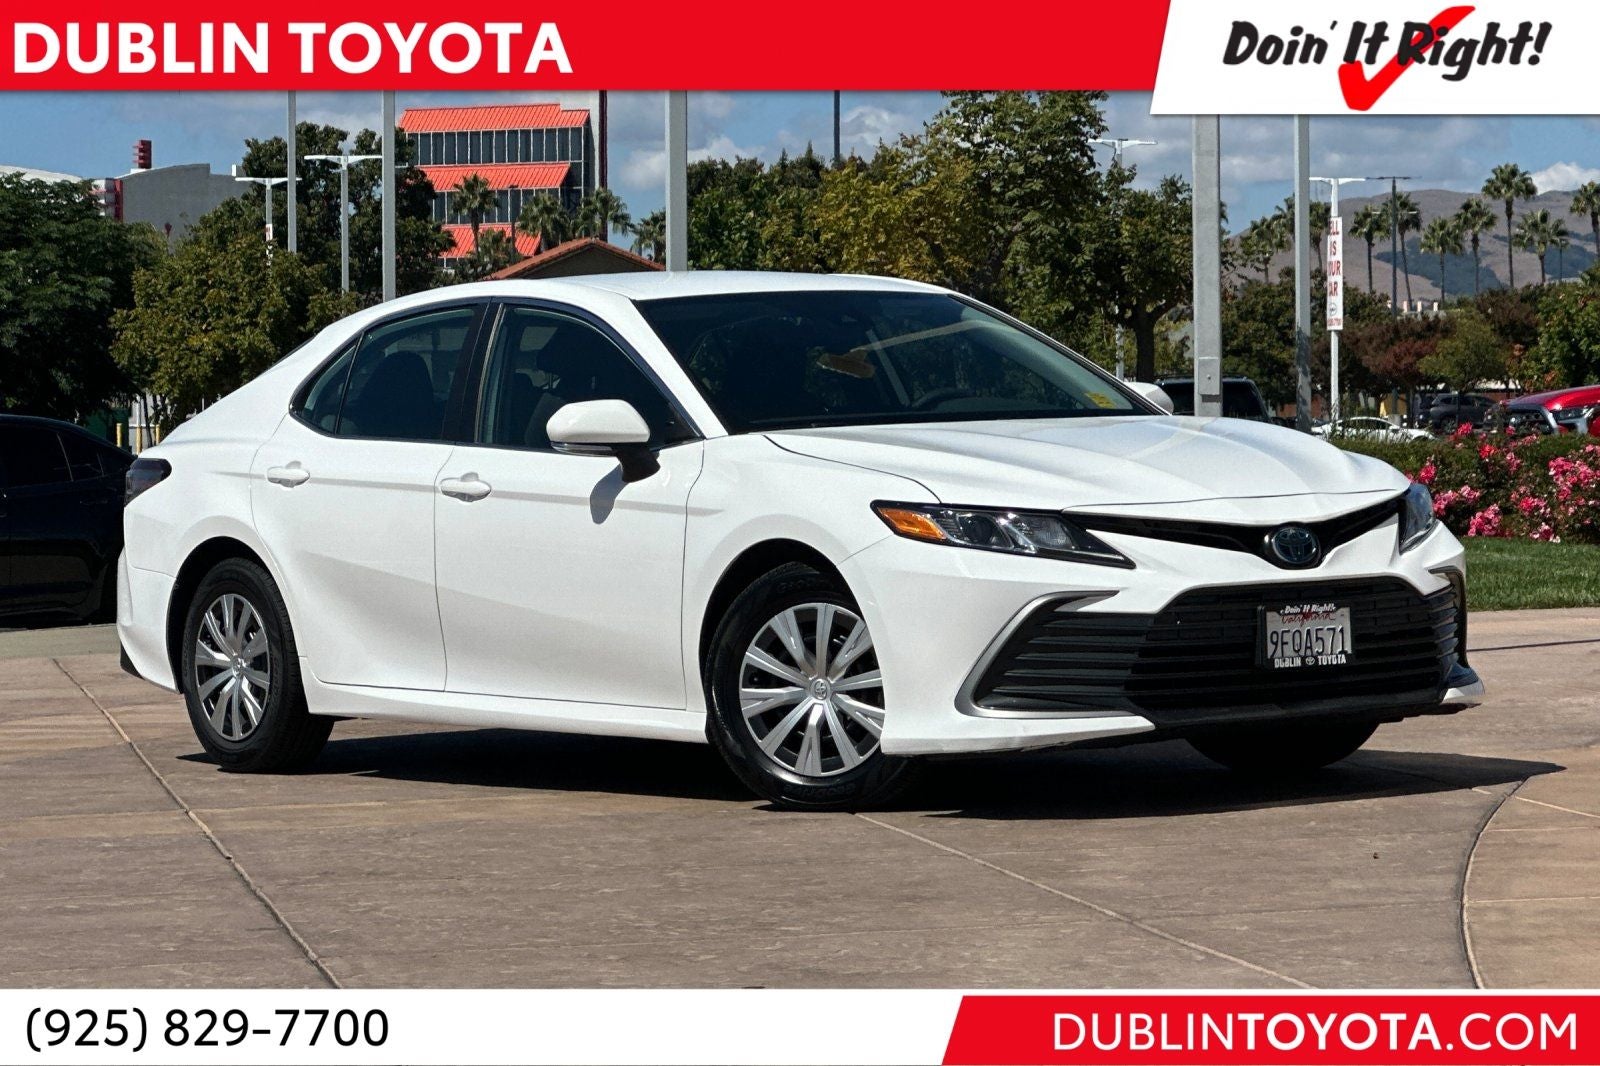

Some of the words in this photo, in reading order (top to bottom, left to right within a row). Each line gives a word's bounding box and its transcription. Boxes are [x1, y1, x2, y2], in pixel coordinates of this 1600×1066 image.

[1269, 625, 1345, 658] 9FQA571
[1274, 657, 1301, 668] DUBLIN
[1317, 654, 1346, 666] TOYOTA
